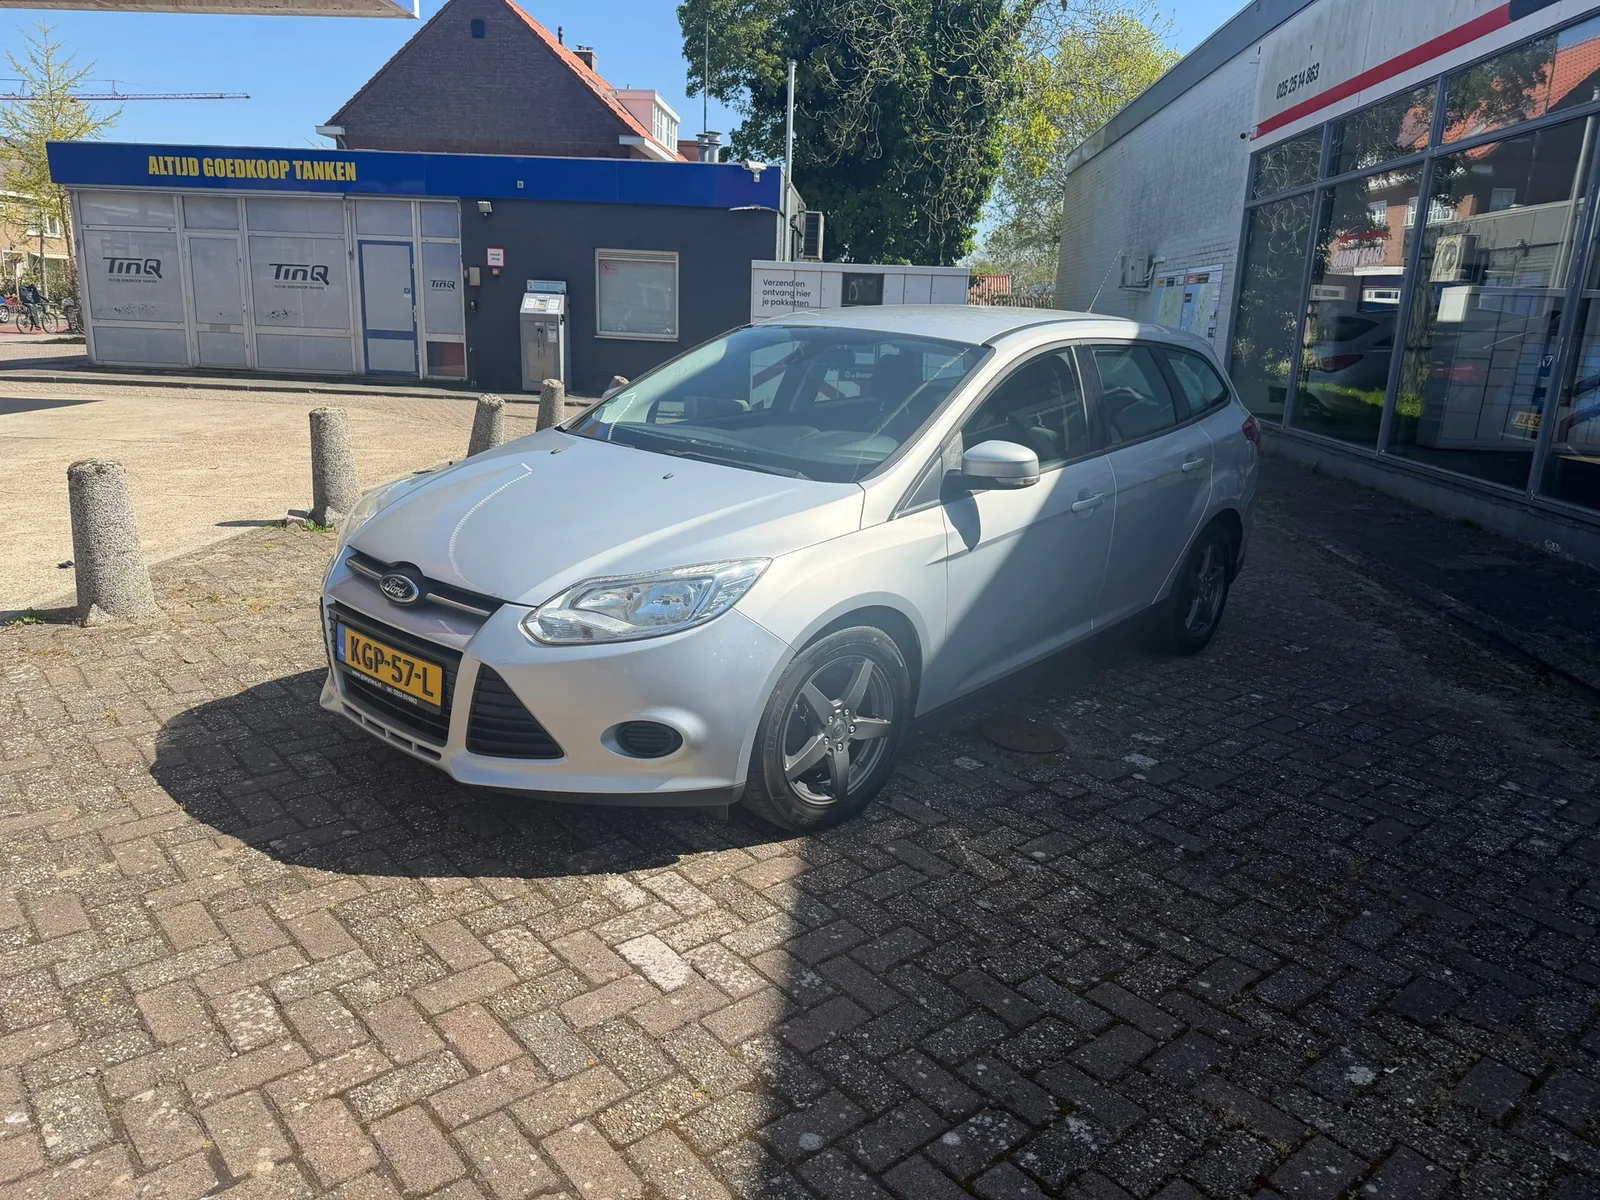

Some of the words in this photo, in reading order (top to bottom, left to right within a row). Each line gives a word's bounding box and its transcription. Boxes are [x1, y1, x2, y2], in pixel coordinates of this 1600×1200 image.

[1276, 79, 1288, 100] 025
[1288, 74, 1298, 94] 25
[1298, 70, 1305, 89] 14
[1306, 62, 1320, 85] 863
[149, 156, 200, 176] ALTIJD
[202, 157, 290, 180] GOEDKOOP
[292, 160, 357, 182] TANKEN
[103, 257, 162, 279] TinQ
[268, 263, 330, 285] TinQ
[762, 279, 794, 287] Verzend
[762, 289, 795, 299] ontvang
[796, 288, 812, 298] hier
[761, 297, 770, 307] je
[770, 298, 809, 308] pakketten
[382, 577, 408, 598] Ford
[338, 645, 346, 657] NL
[351, 635, 434, 698] KGP-57-L
